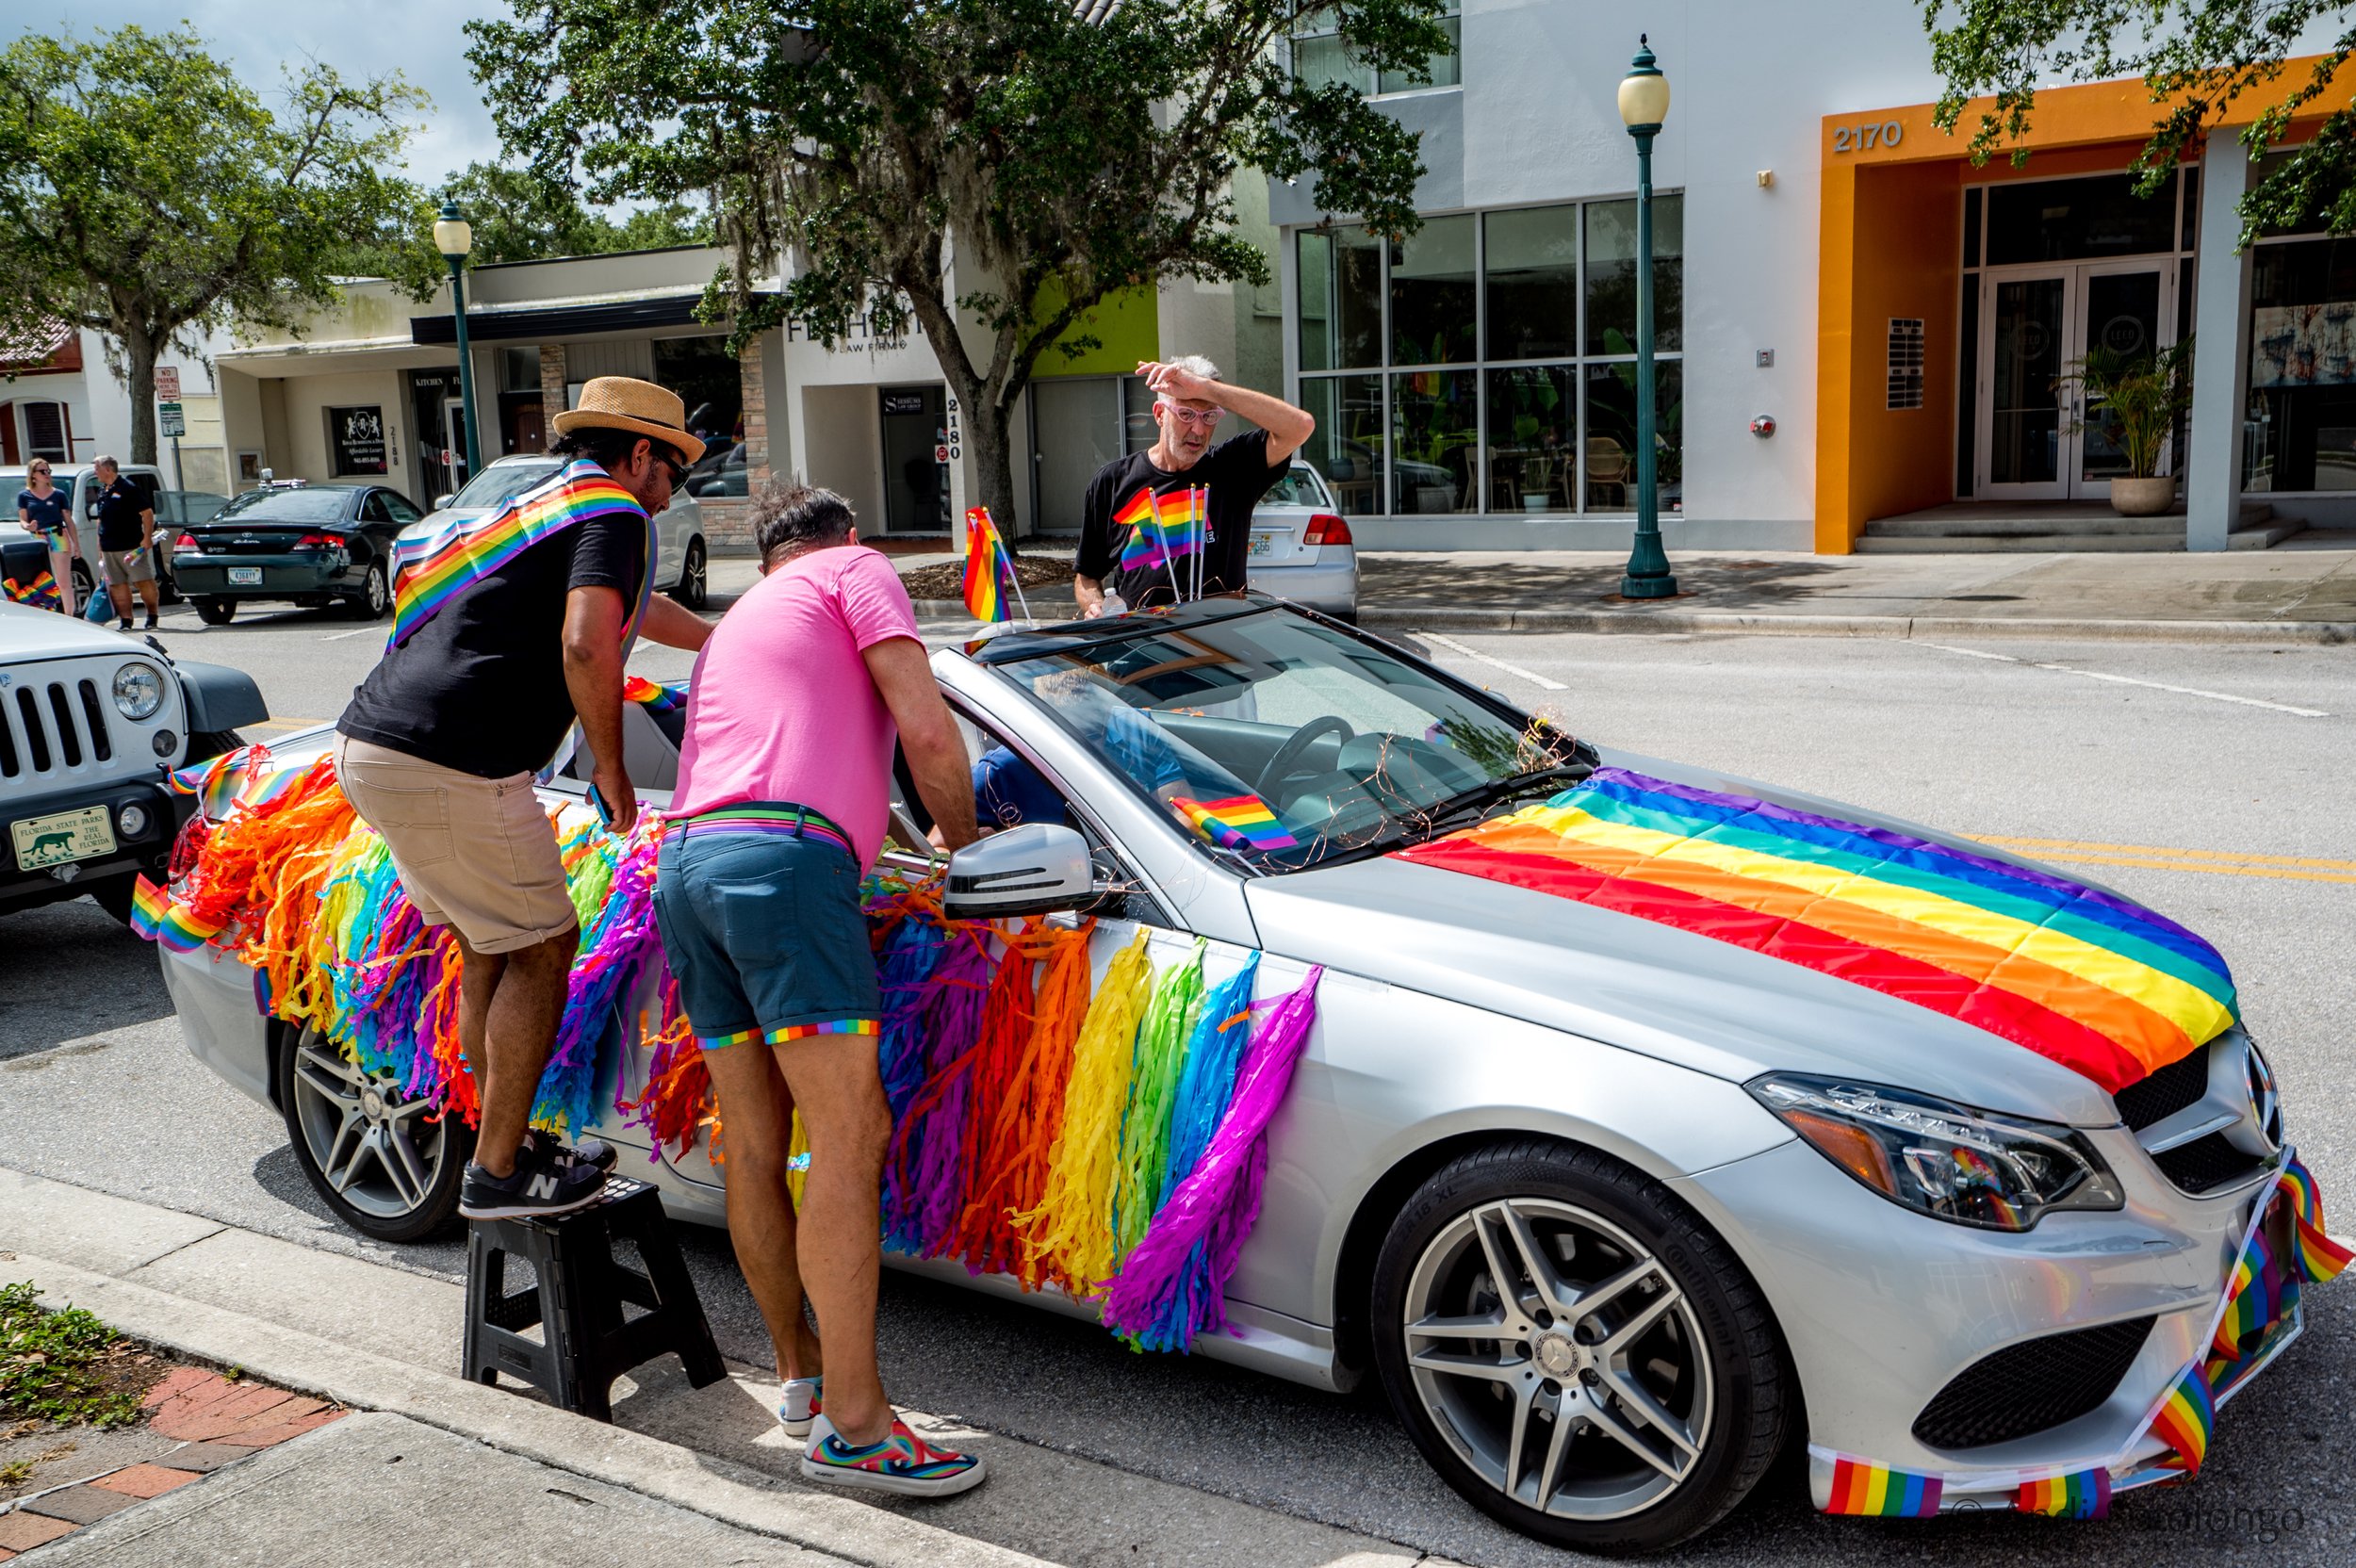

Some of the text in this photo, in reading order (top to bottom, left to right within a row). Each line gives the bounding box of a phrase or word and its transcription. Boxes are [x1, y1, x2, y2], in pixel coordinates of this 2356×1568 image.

[1834, 121, 1902, 152] 2170
[868, 341, 897, 351] FIRM
[416, 378, 443, 386] KITCHEN
[948, 399, 960, 460] 2180
[390, 426, 399, 466] 2188
[20, 814, 104, 837] FLORIDA STATE PARKS
[79, 838, 110, 849] FLORIDA
[84, 832, 103, 841] REAL
[526, 1173, 559, 1200] N
[1435, 1185, 1459, 1204] XL
